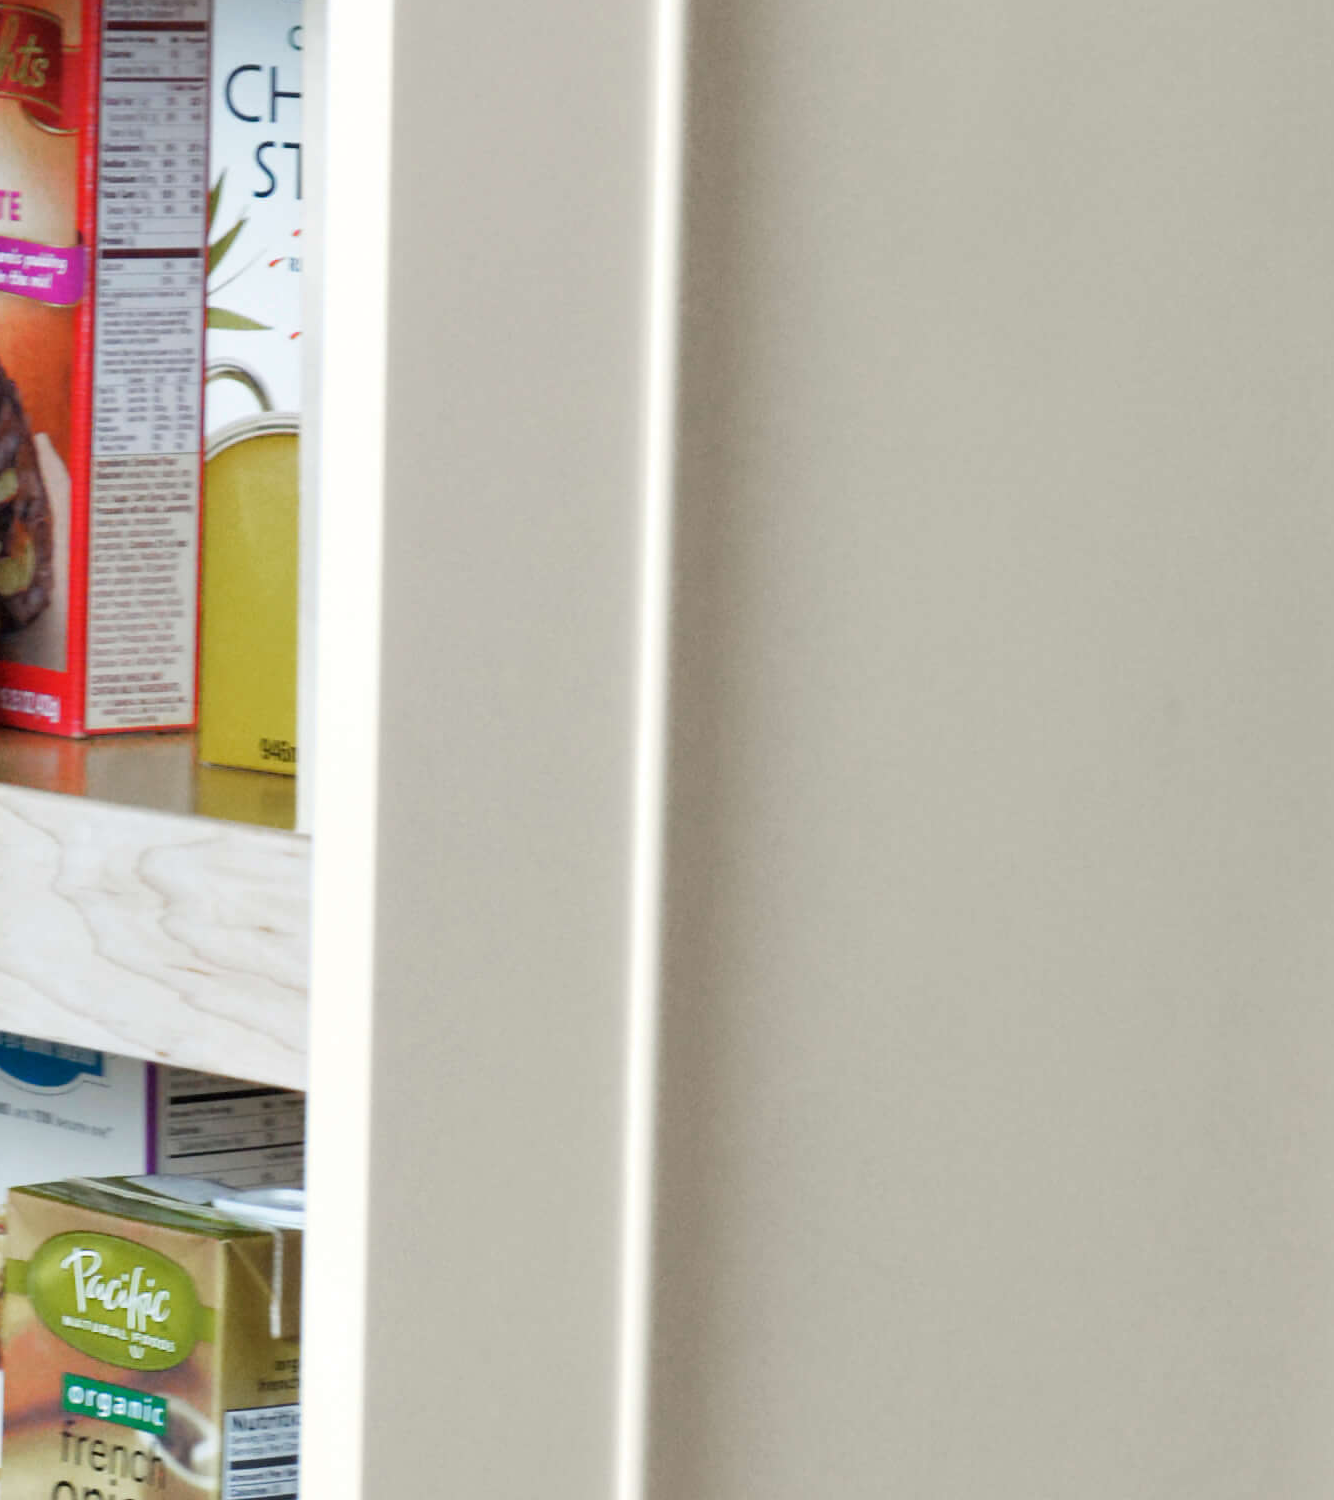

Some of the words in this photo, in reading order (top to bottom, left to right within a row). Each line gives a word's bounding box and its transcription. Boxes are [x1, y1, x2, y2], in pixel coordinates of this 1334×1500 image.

[60, 1246, 172, 1333] Pacific
[66, 1384, 166, 1427] organic
[60, 1418, 167, 1490] french
